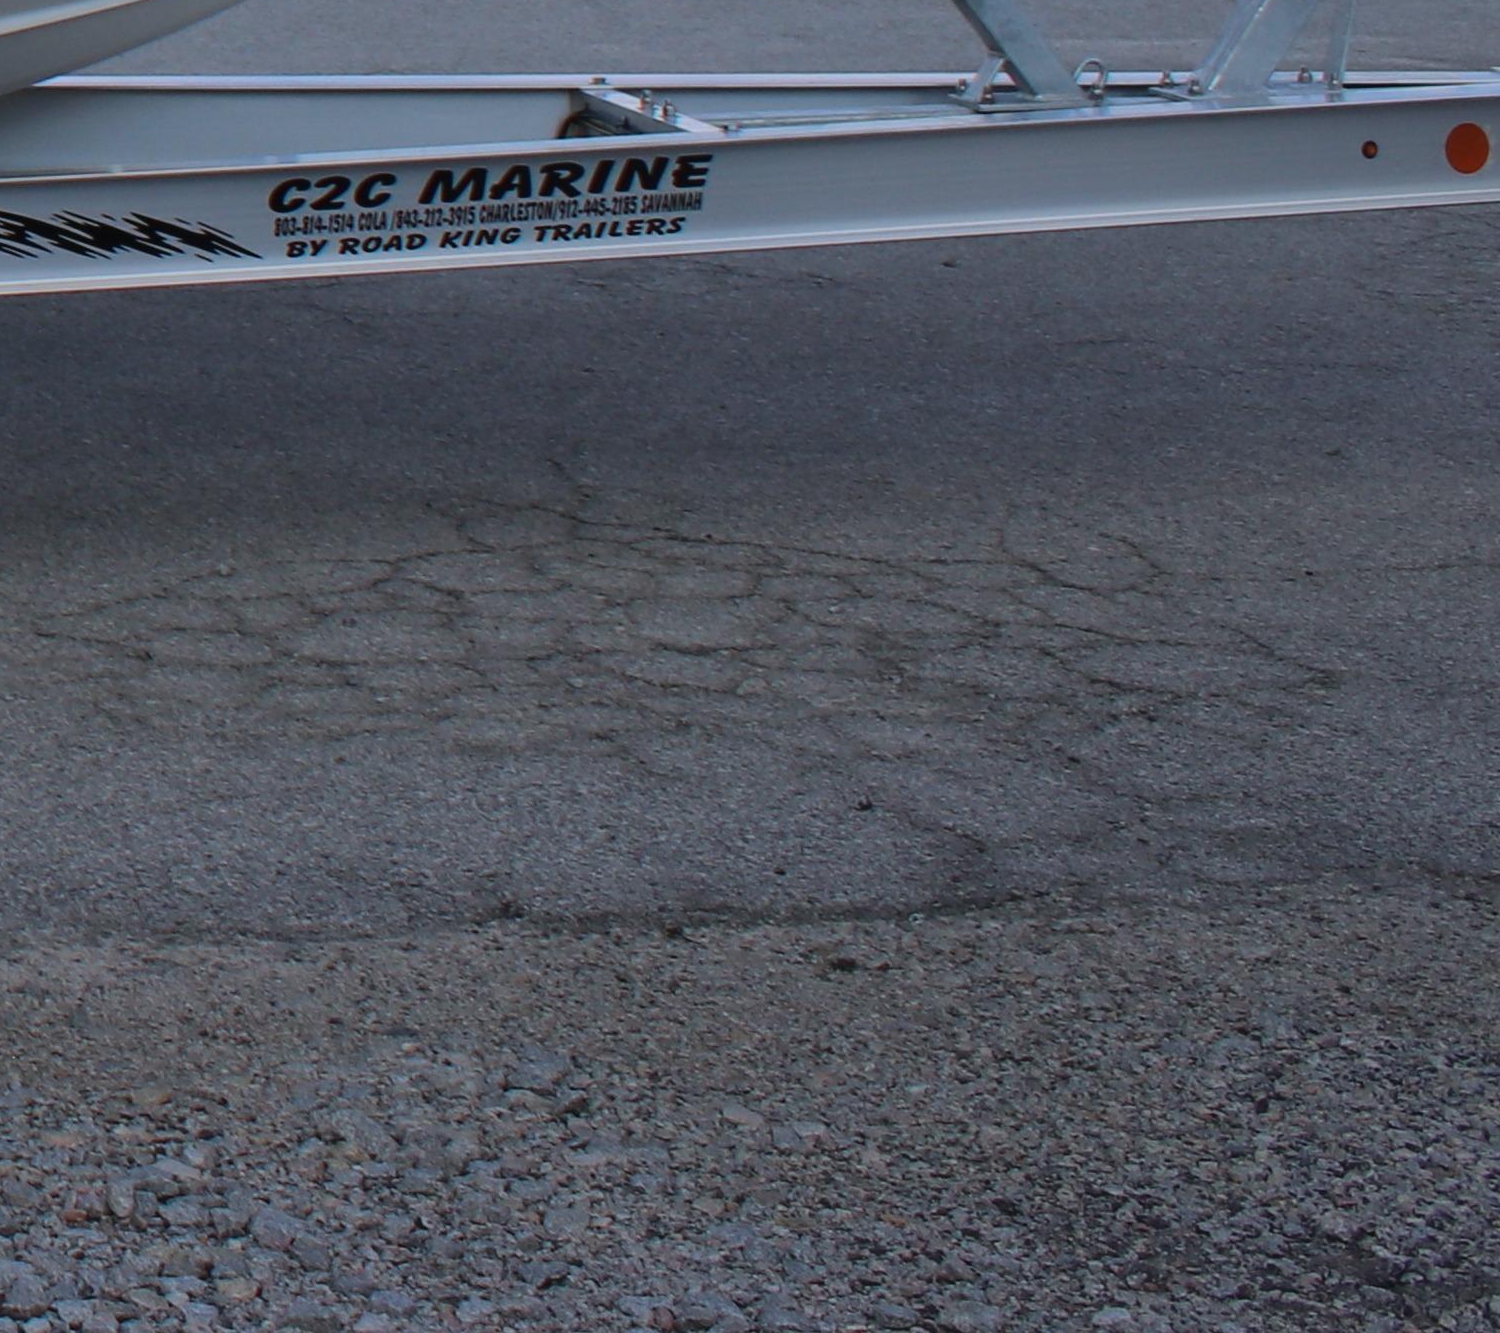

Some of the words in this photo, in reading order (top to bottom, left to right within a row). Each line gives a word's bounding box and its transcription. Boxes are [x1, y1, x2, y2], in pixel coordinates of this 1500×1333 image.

[268, 172, 397, 214] C2C
[418, 154, 713, 205] MARINE
[274, 212, 354, 237] 803-814-1514
[358, 210, 387, 232] COLA
[640, 191, 704, 214] SAVANNAH
[286, 238, 329, 258] BY
[338, 233, 427, 255] ROAD
[439, 227, 522, 249] KING
[534, 216, 687, 242] TRAILERS
